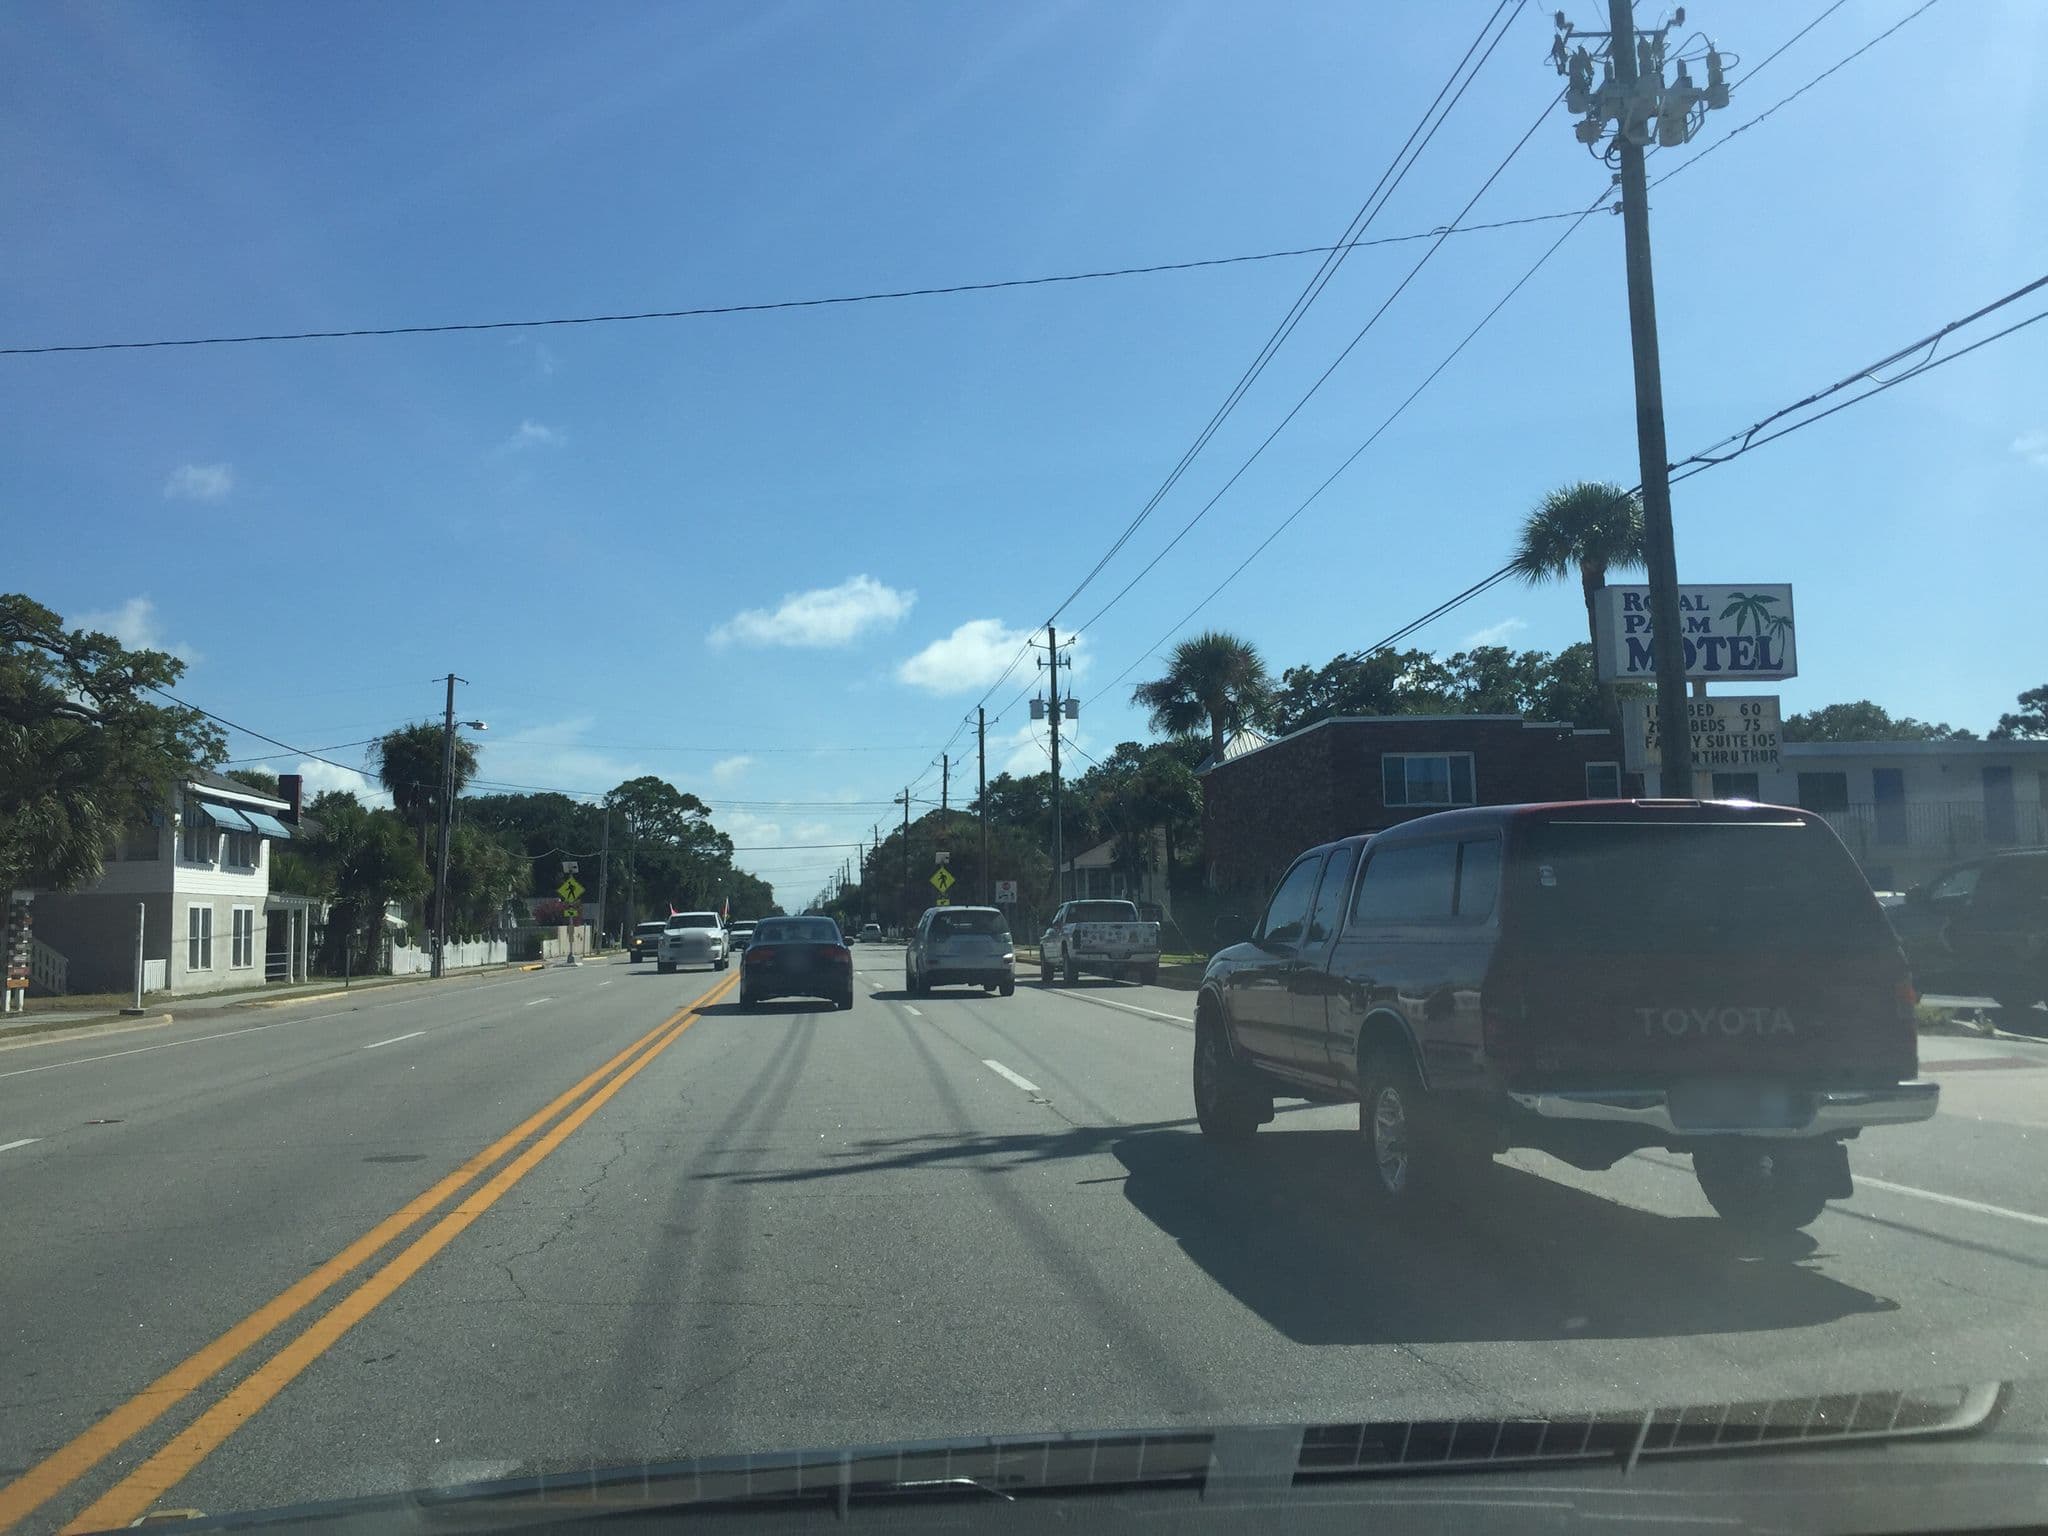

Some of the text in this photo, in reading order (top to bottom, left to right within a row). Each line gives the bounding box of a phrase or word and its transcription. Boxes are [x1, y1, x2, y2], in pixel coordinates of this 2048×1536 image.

[1622, 592, 1709, 611] RAL
[1623, 615, 1712, 634] PM
[1740, 703, 1761, 716] 60
[1691, 719, 1726, 732] BEDS
[1744, 719, 1761, 731] 75
[1707, 734, 1748, 748] SUITE
[1752, 734, 1777, 747] 105
[1703, 750, 1739, 763] THRU
[1635, 1007, 1795, 1036] TOYOTA
